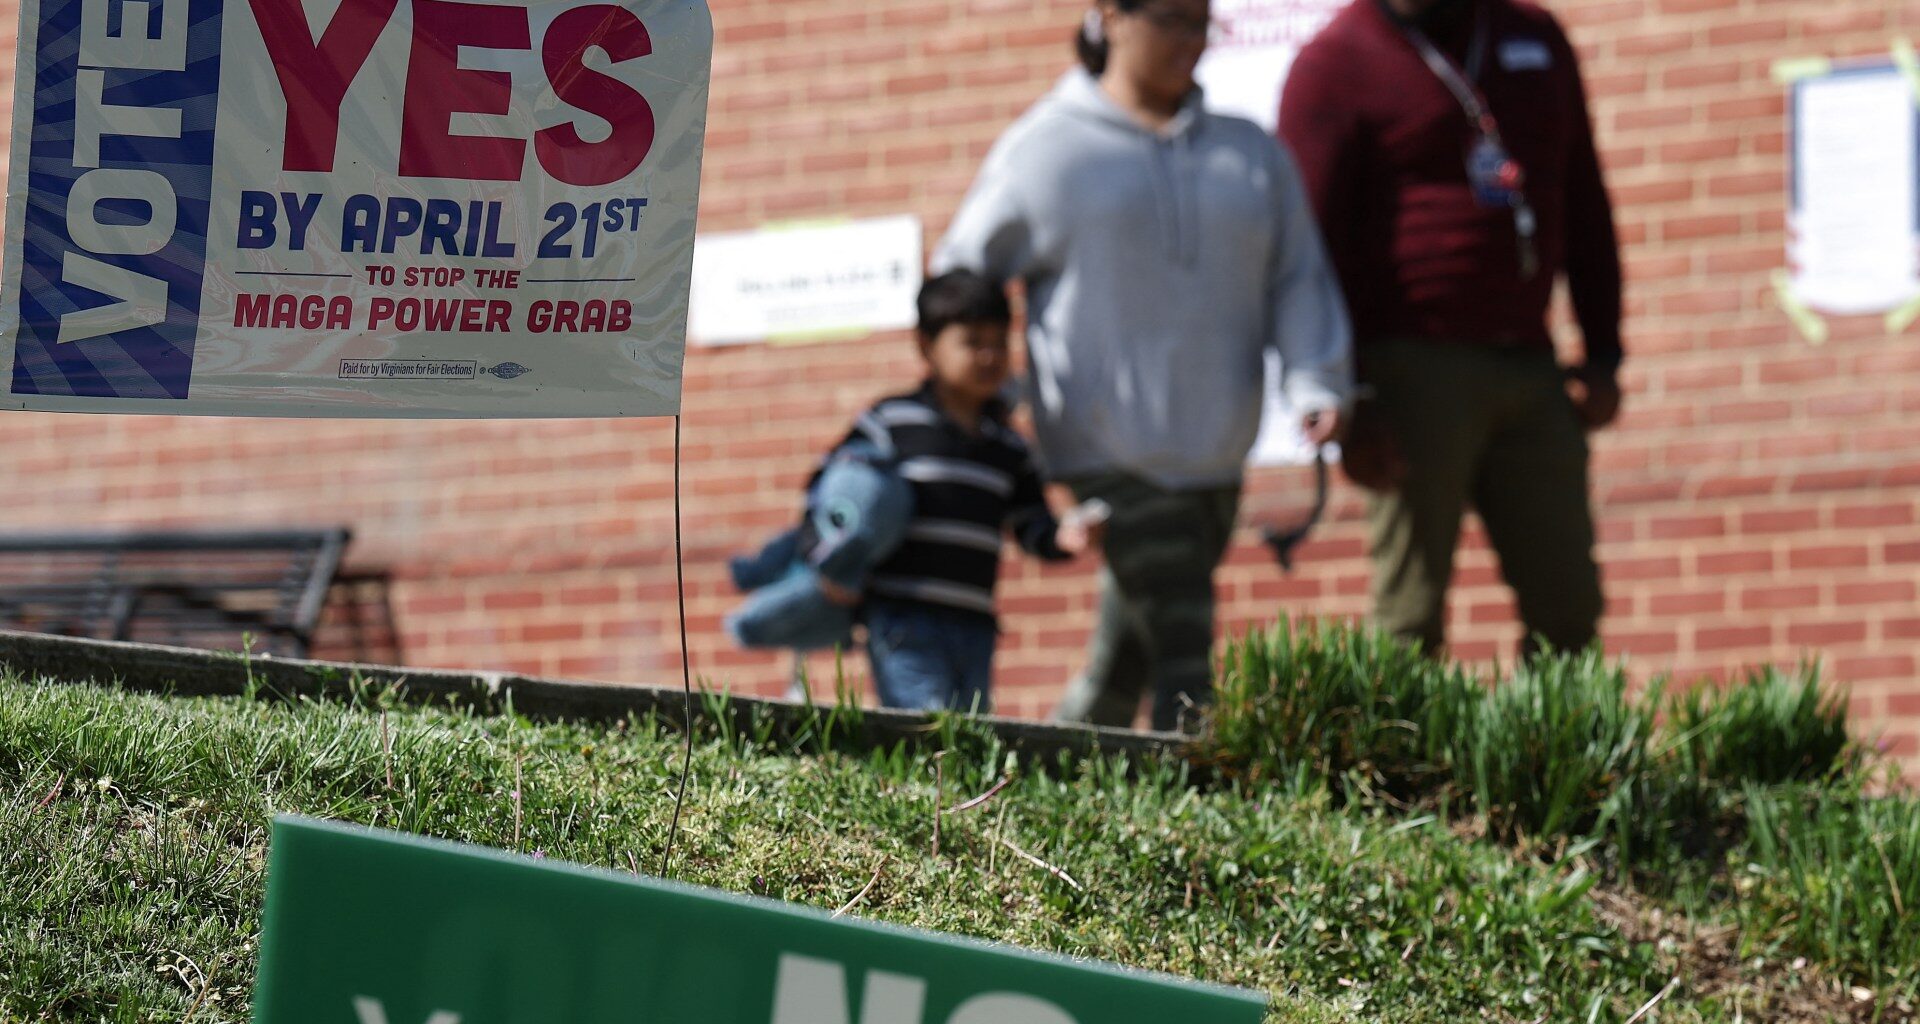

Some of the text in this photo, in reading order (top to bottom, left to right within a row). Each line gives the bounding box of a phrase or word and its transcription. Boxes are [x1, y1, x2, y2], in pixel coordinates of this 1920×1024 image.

[247, 0, 656, 186] YES
[57, 0, 188, 344] VOTE
[236, 190, 648, 259] BY APRIL 21ST
[365, 265, 521, 290] TO STOP THE
[233, 293, 633, 334] MAGA POWER GRAB
[342, 362, 358, 375] Paid
[359, 362, 370, 375] for
[371, 363, 379, 377] by
[380, 363, 414, 377] Virginians
[415, 363, 426, 375] for
[427, 364, 440, 375] Fair
[440, 364, 472, 376] Elections
